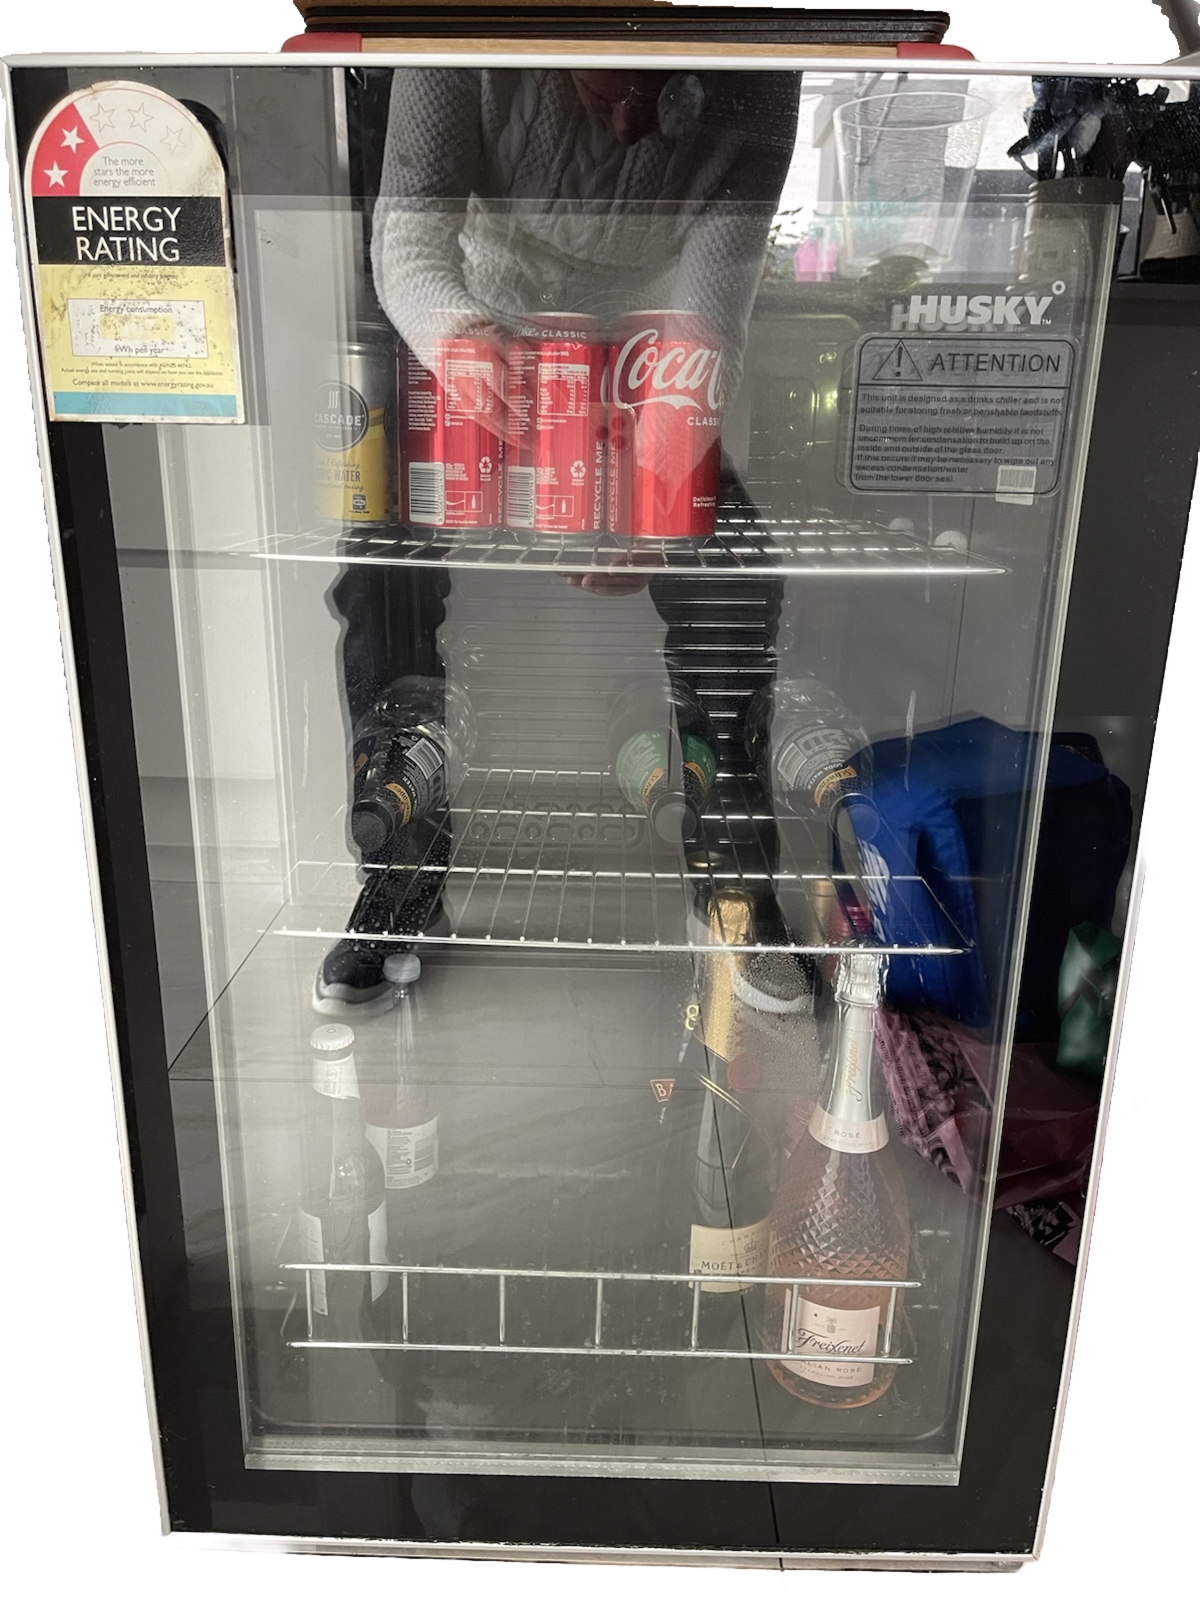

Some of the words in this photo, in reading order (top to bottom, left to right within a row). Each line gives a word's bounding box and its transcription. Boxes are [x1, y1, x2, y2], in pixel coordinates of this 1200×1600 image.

[102, 156, 118, 166] The
[116, 167, 129, 176] the
[93, 179, 120, 188] energy
[123, 177, 156, 186] efficient
[72, 206, 182, 232] ENERGY
[76, 236, 180, 262] RATING
[100, 305, 124, 314] Energy
[126, 305, 172, 314] consumption
[908, 295, 1054, 325] HUSKY
[542, 330, 587, 339] CLASSIC
[930, 353, 1061, 372] ATTENTION
[882, 394, 898, 402] unit
[908, 394, 946, 404] designed
[908, 407, 938, 416] storing
[940, 407, 961, 415] fresh
[974, 408, 1019, 417] perishable
[314, 413, 362, 426] CASCADE
[860, 424, 887, 433] During
[924, 426, 941, 434] high
[976, 427, 1012, 435] humidity
[908, 435, 920, 443] for
[921, 435, 978, 444] condensation
[595, 441, 603, 463] ME
[960, 447, 981, 455] glass
[334, 470, 361, 482] WATER
[593, 467, 602, 530] RECYCLE
[823, 762, 844, 772] SODA
[807, 770, 824, 789] WATER
[834, 1130, 861, 1139] ROSÉ
[794, 1328, 866, 1354] Freixenet
